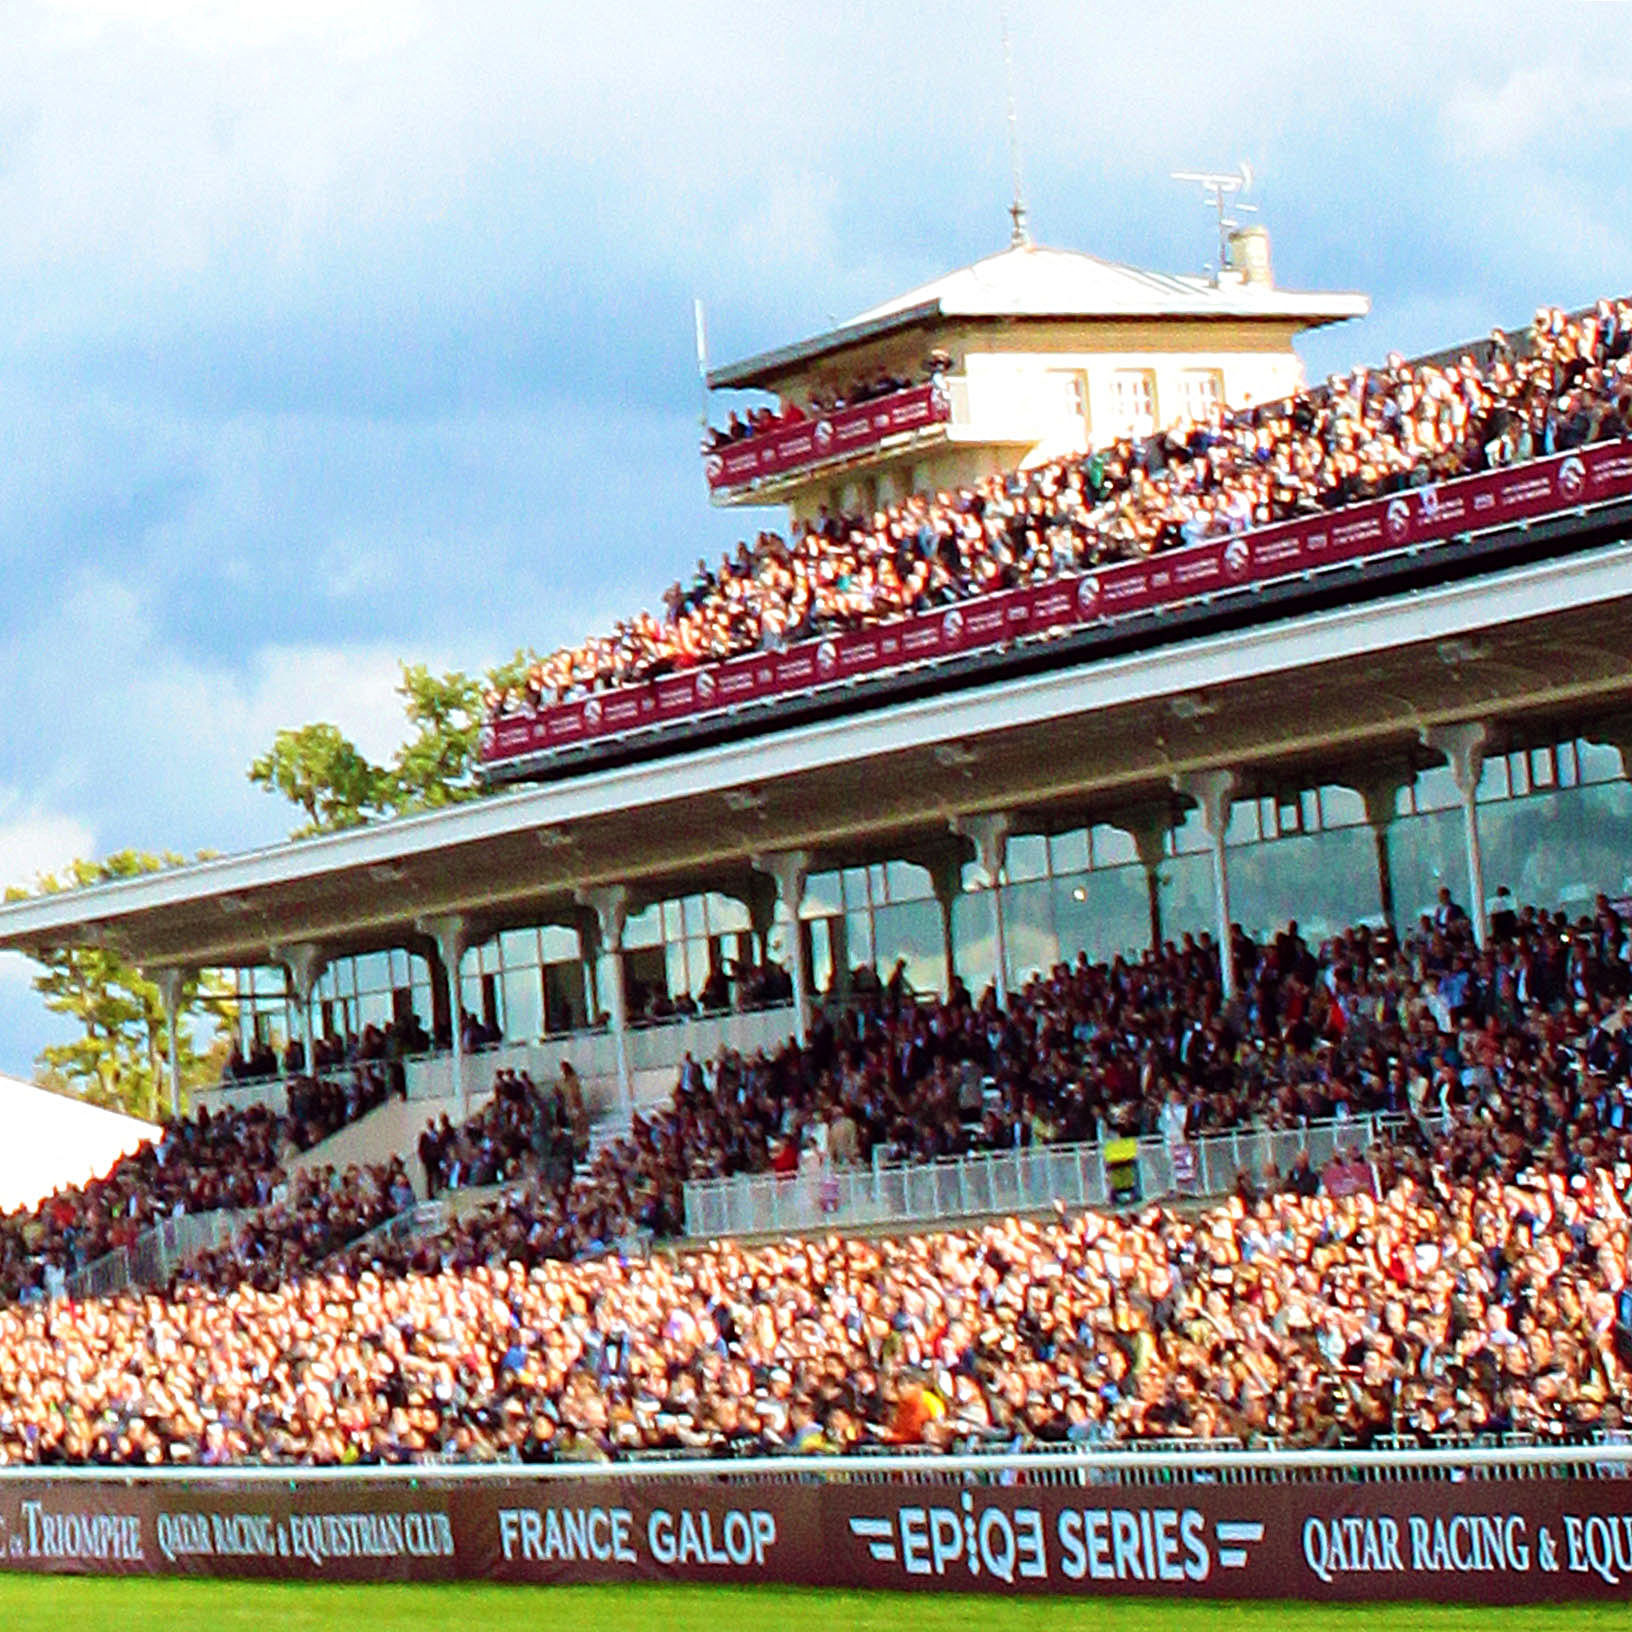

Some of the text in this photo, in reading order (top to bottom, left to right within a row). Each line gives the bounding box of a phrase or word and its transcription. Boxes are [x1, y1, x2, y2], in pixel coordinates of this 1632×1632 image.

[498, 1508, 776, 1565] FRANCE GALOP
[1058, 1508, 1210, 1581] SERIES
[1303, 1515, 1404, 1582] QATAR
[1409, 1514, 1530, 1571] RACING
[1539, 1527, 1559, 1572] &
